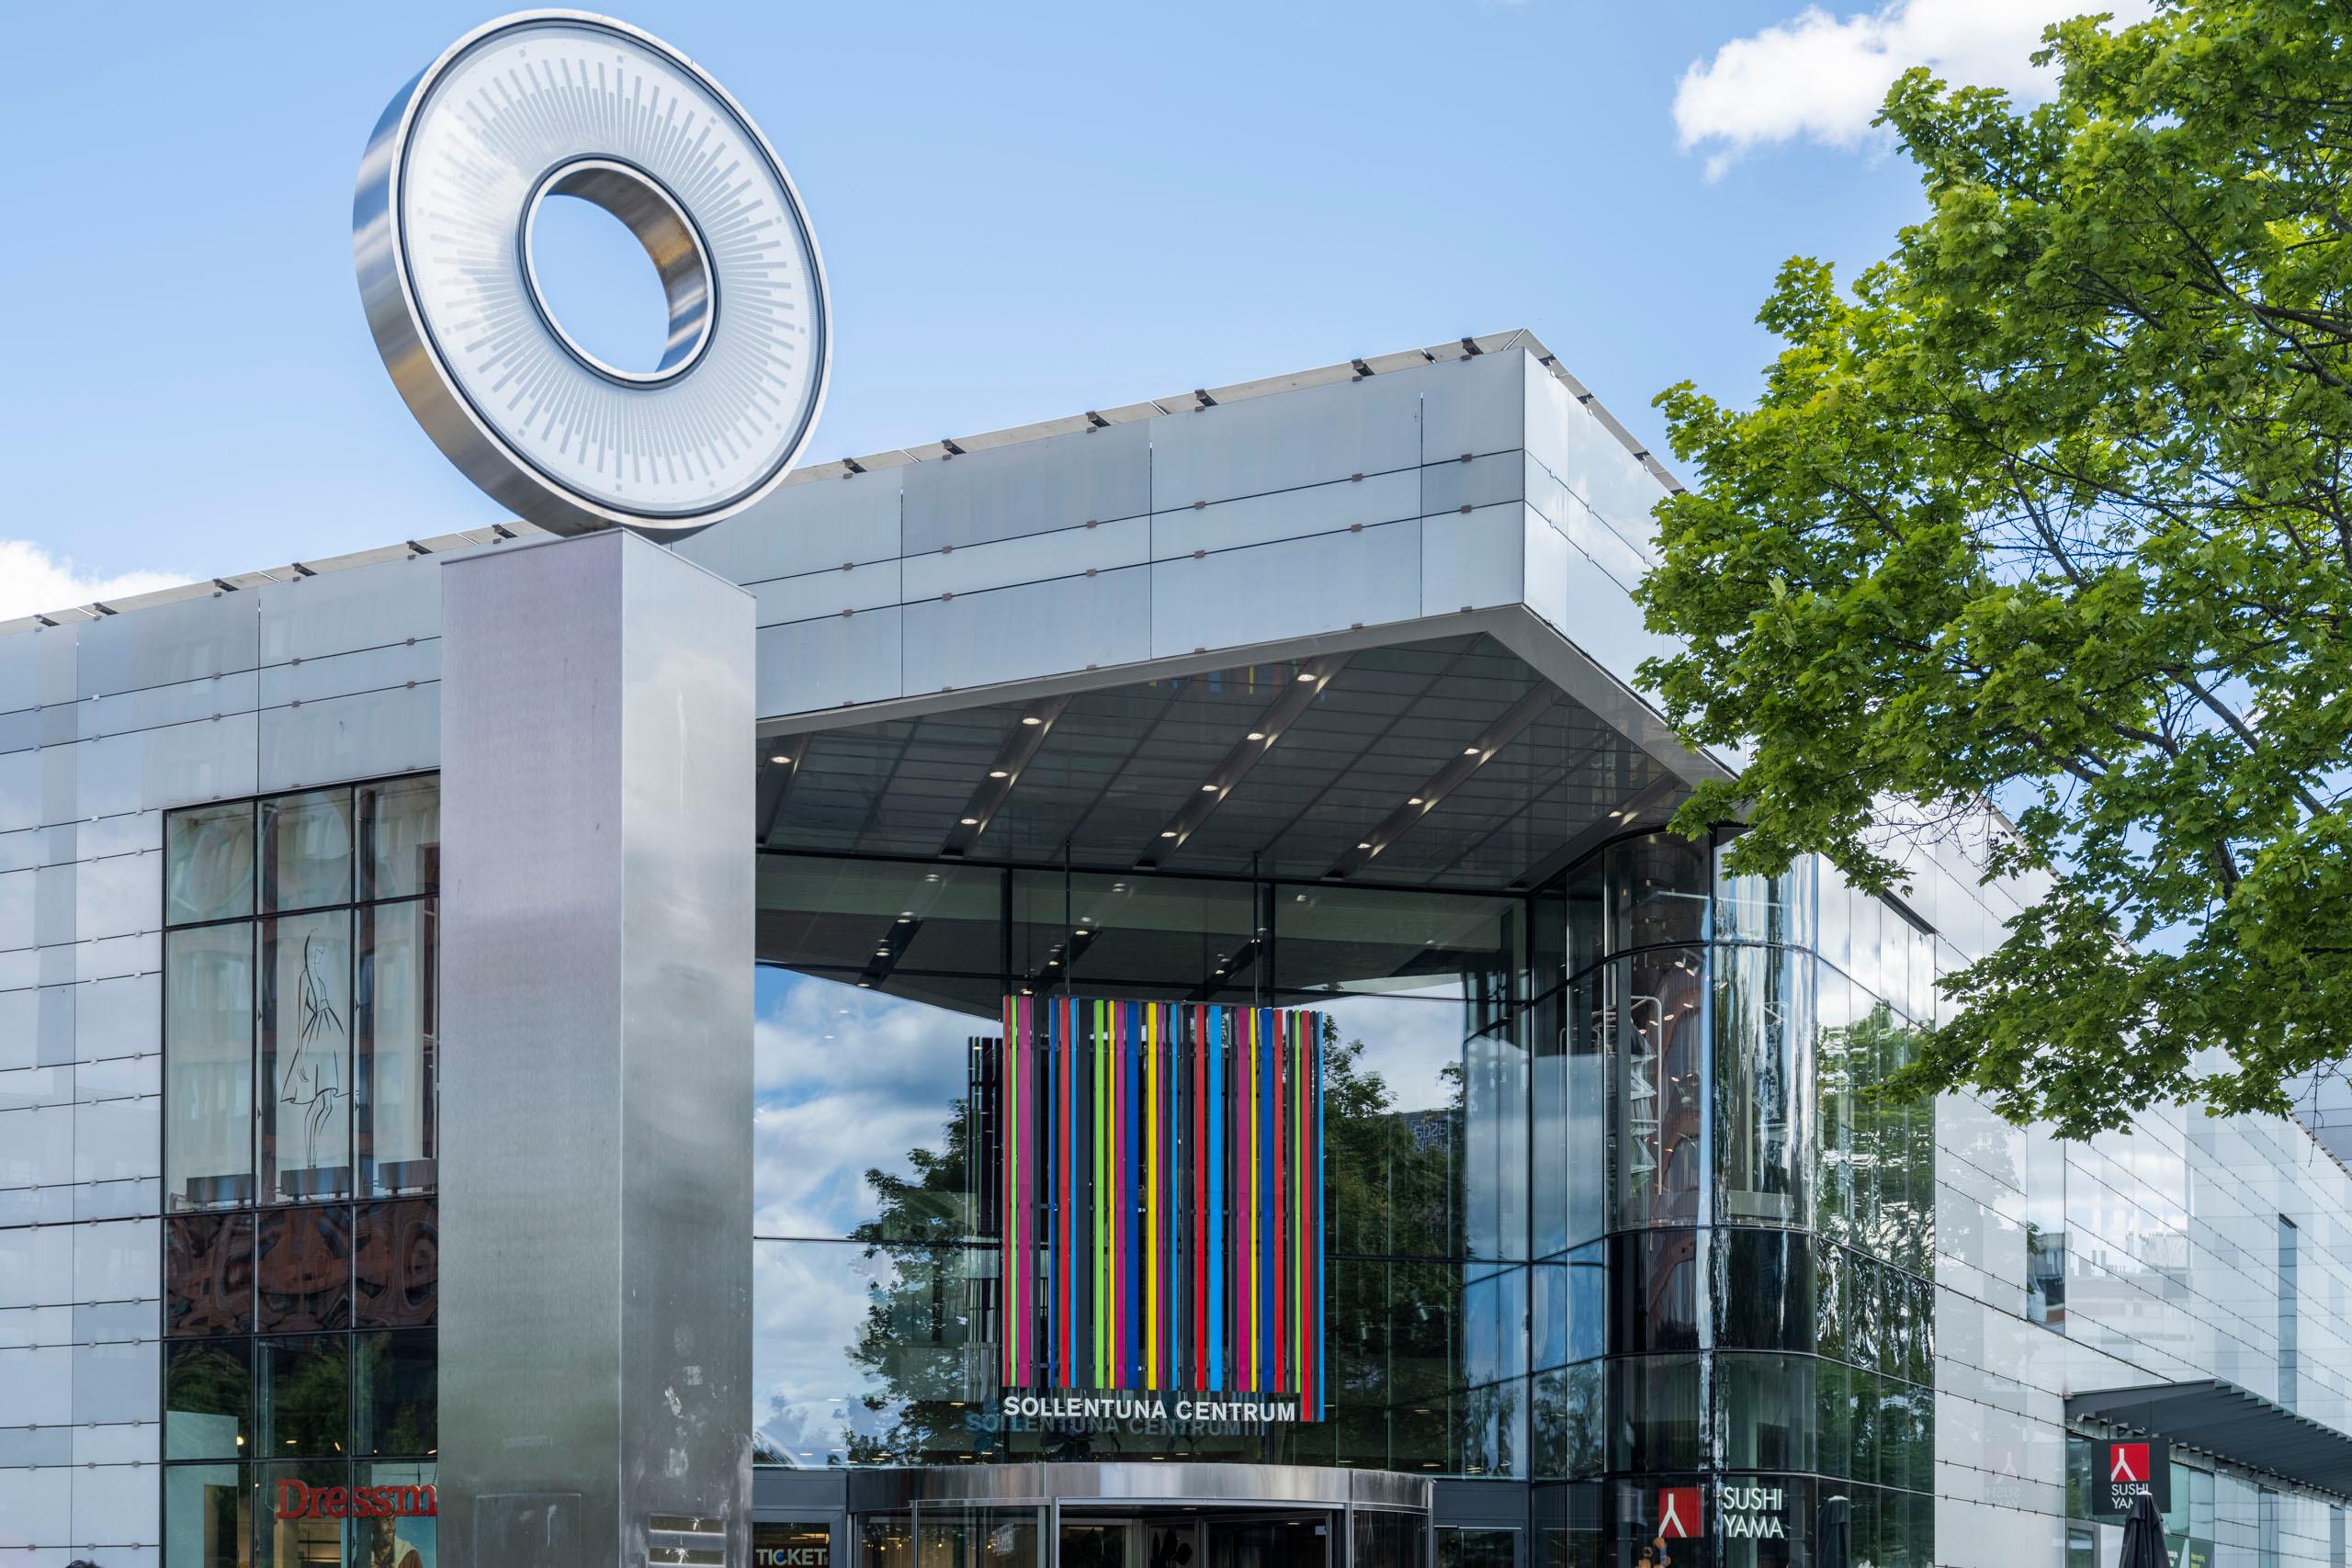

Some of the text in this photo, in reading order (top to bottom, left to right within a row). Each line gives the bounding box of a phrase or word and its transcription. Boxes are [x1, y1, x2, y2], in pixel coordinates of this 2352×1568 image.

[1003, 1396, 1295, 1422] SOLLENTUNA CENTRUM
[276, 1479, 437, 1519] Dressm
[1723, 1487, 1782, 1510] SUSHI
[2111, 1483, 2149, 1496] SUSHI
[1724, 1514, 1785, 1539] YAMA
[755, 1548, 827, 1566] TICKET
